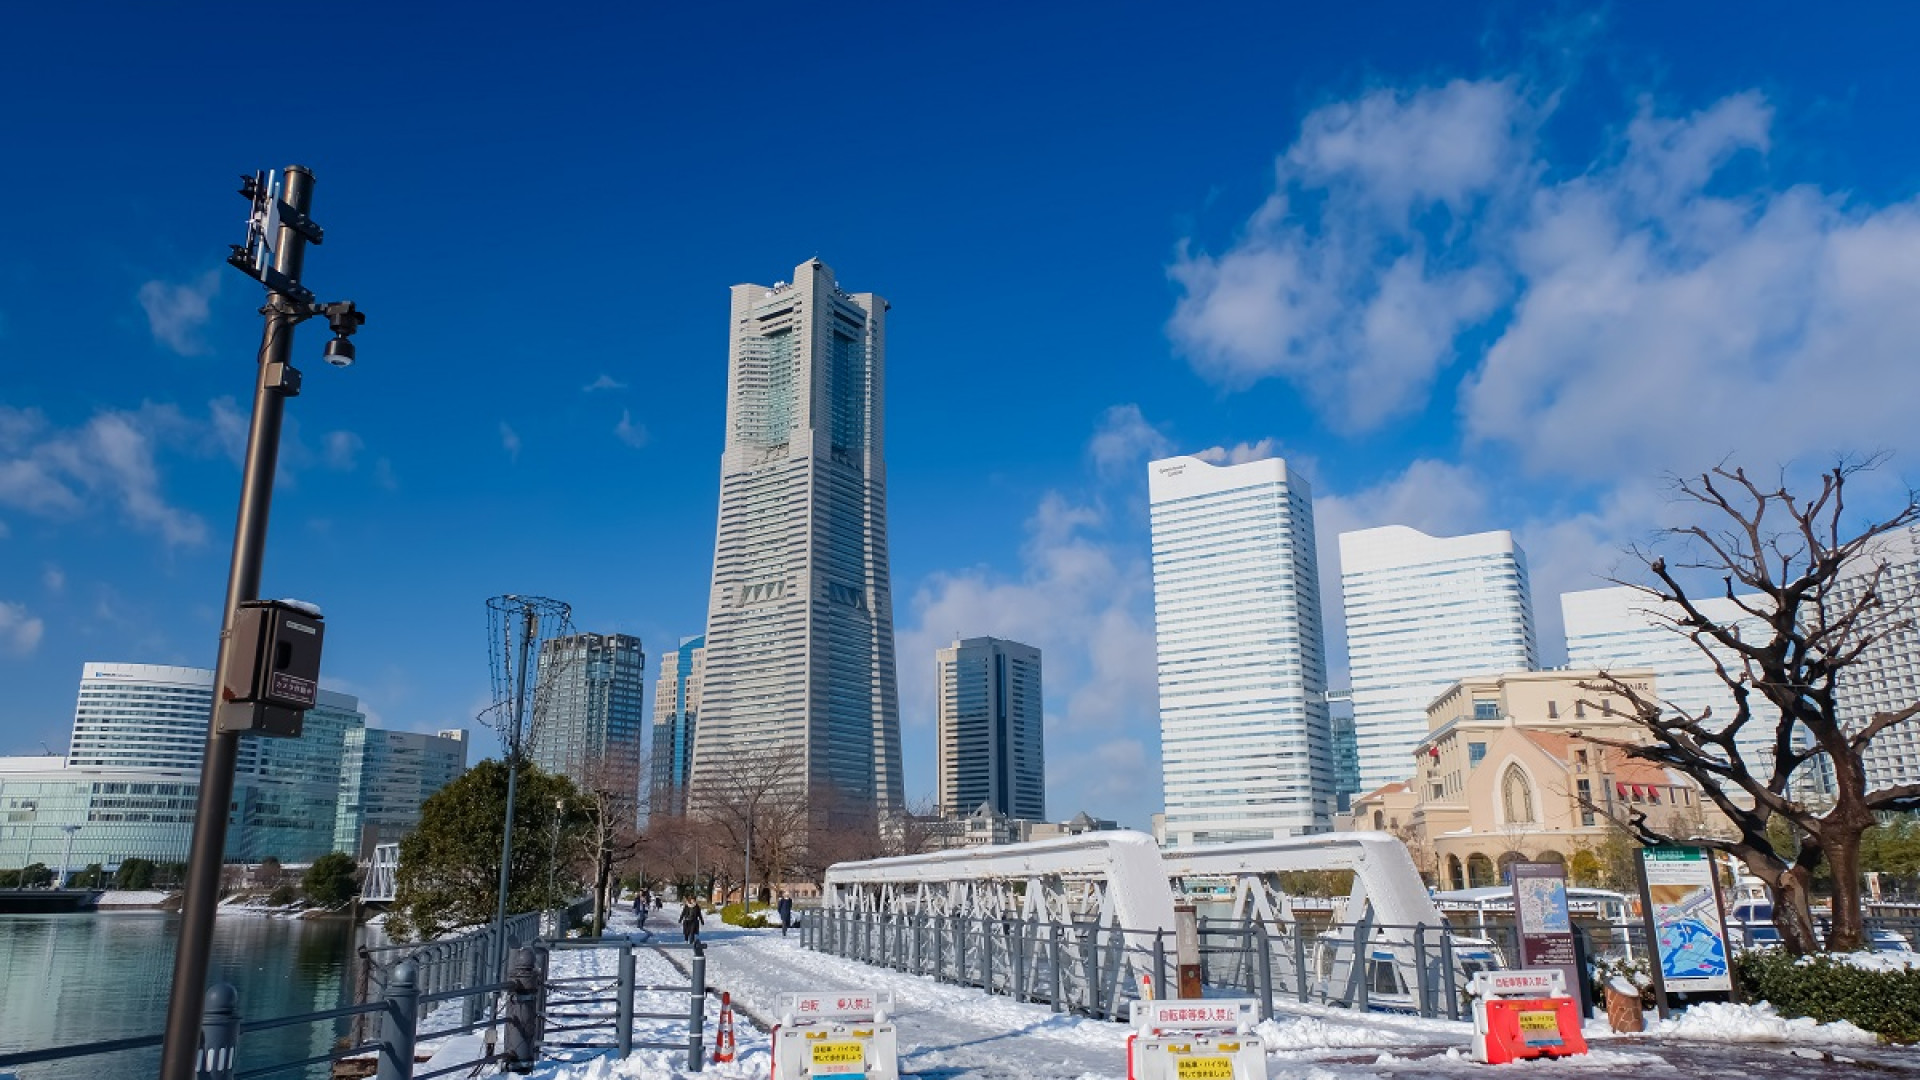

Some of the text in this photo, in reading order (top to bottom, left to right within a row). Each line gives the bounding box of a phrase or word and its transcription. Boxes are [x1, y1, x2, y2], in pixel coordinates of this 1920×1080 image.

[1495, 976, 1550, 988] 自転車等乗入禁止
[1159, 1007, 1235, 1022] 自転車等乗入禁止
